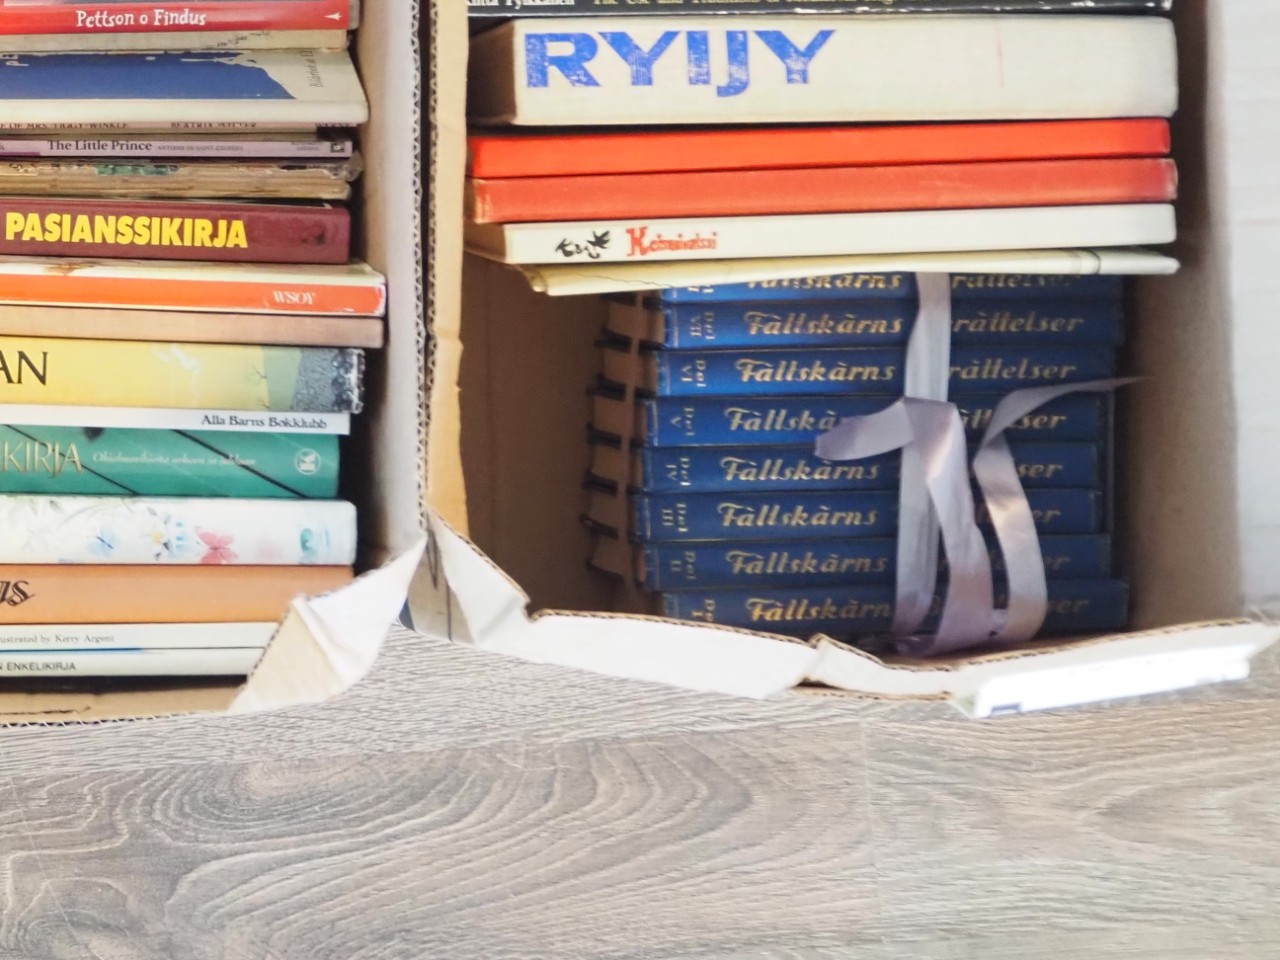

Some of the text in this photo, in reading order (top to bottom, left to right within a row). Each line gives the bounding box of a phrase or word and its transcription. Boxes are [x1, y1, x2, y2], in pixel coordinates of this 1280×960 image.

[76, 9, 134, 28] Pettson
[139, 15, 148, 24] o
[154, 8, 207, 26] Findus
[524, 28, 838, 99] RYIJY
[6, 211, 249, 249] PASIANSSIKIRJA
[273, 290, 316, 305] WSOY
[201, 414, 226, 426] Alla
[229, 415, 265, 428] Barns
[269, 416, 327, 430] Bokklubb
[6, 661, 76, 672] ENKELIKIRJA
